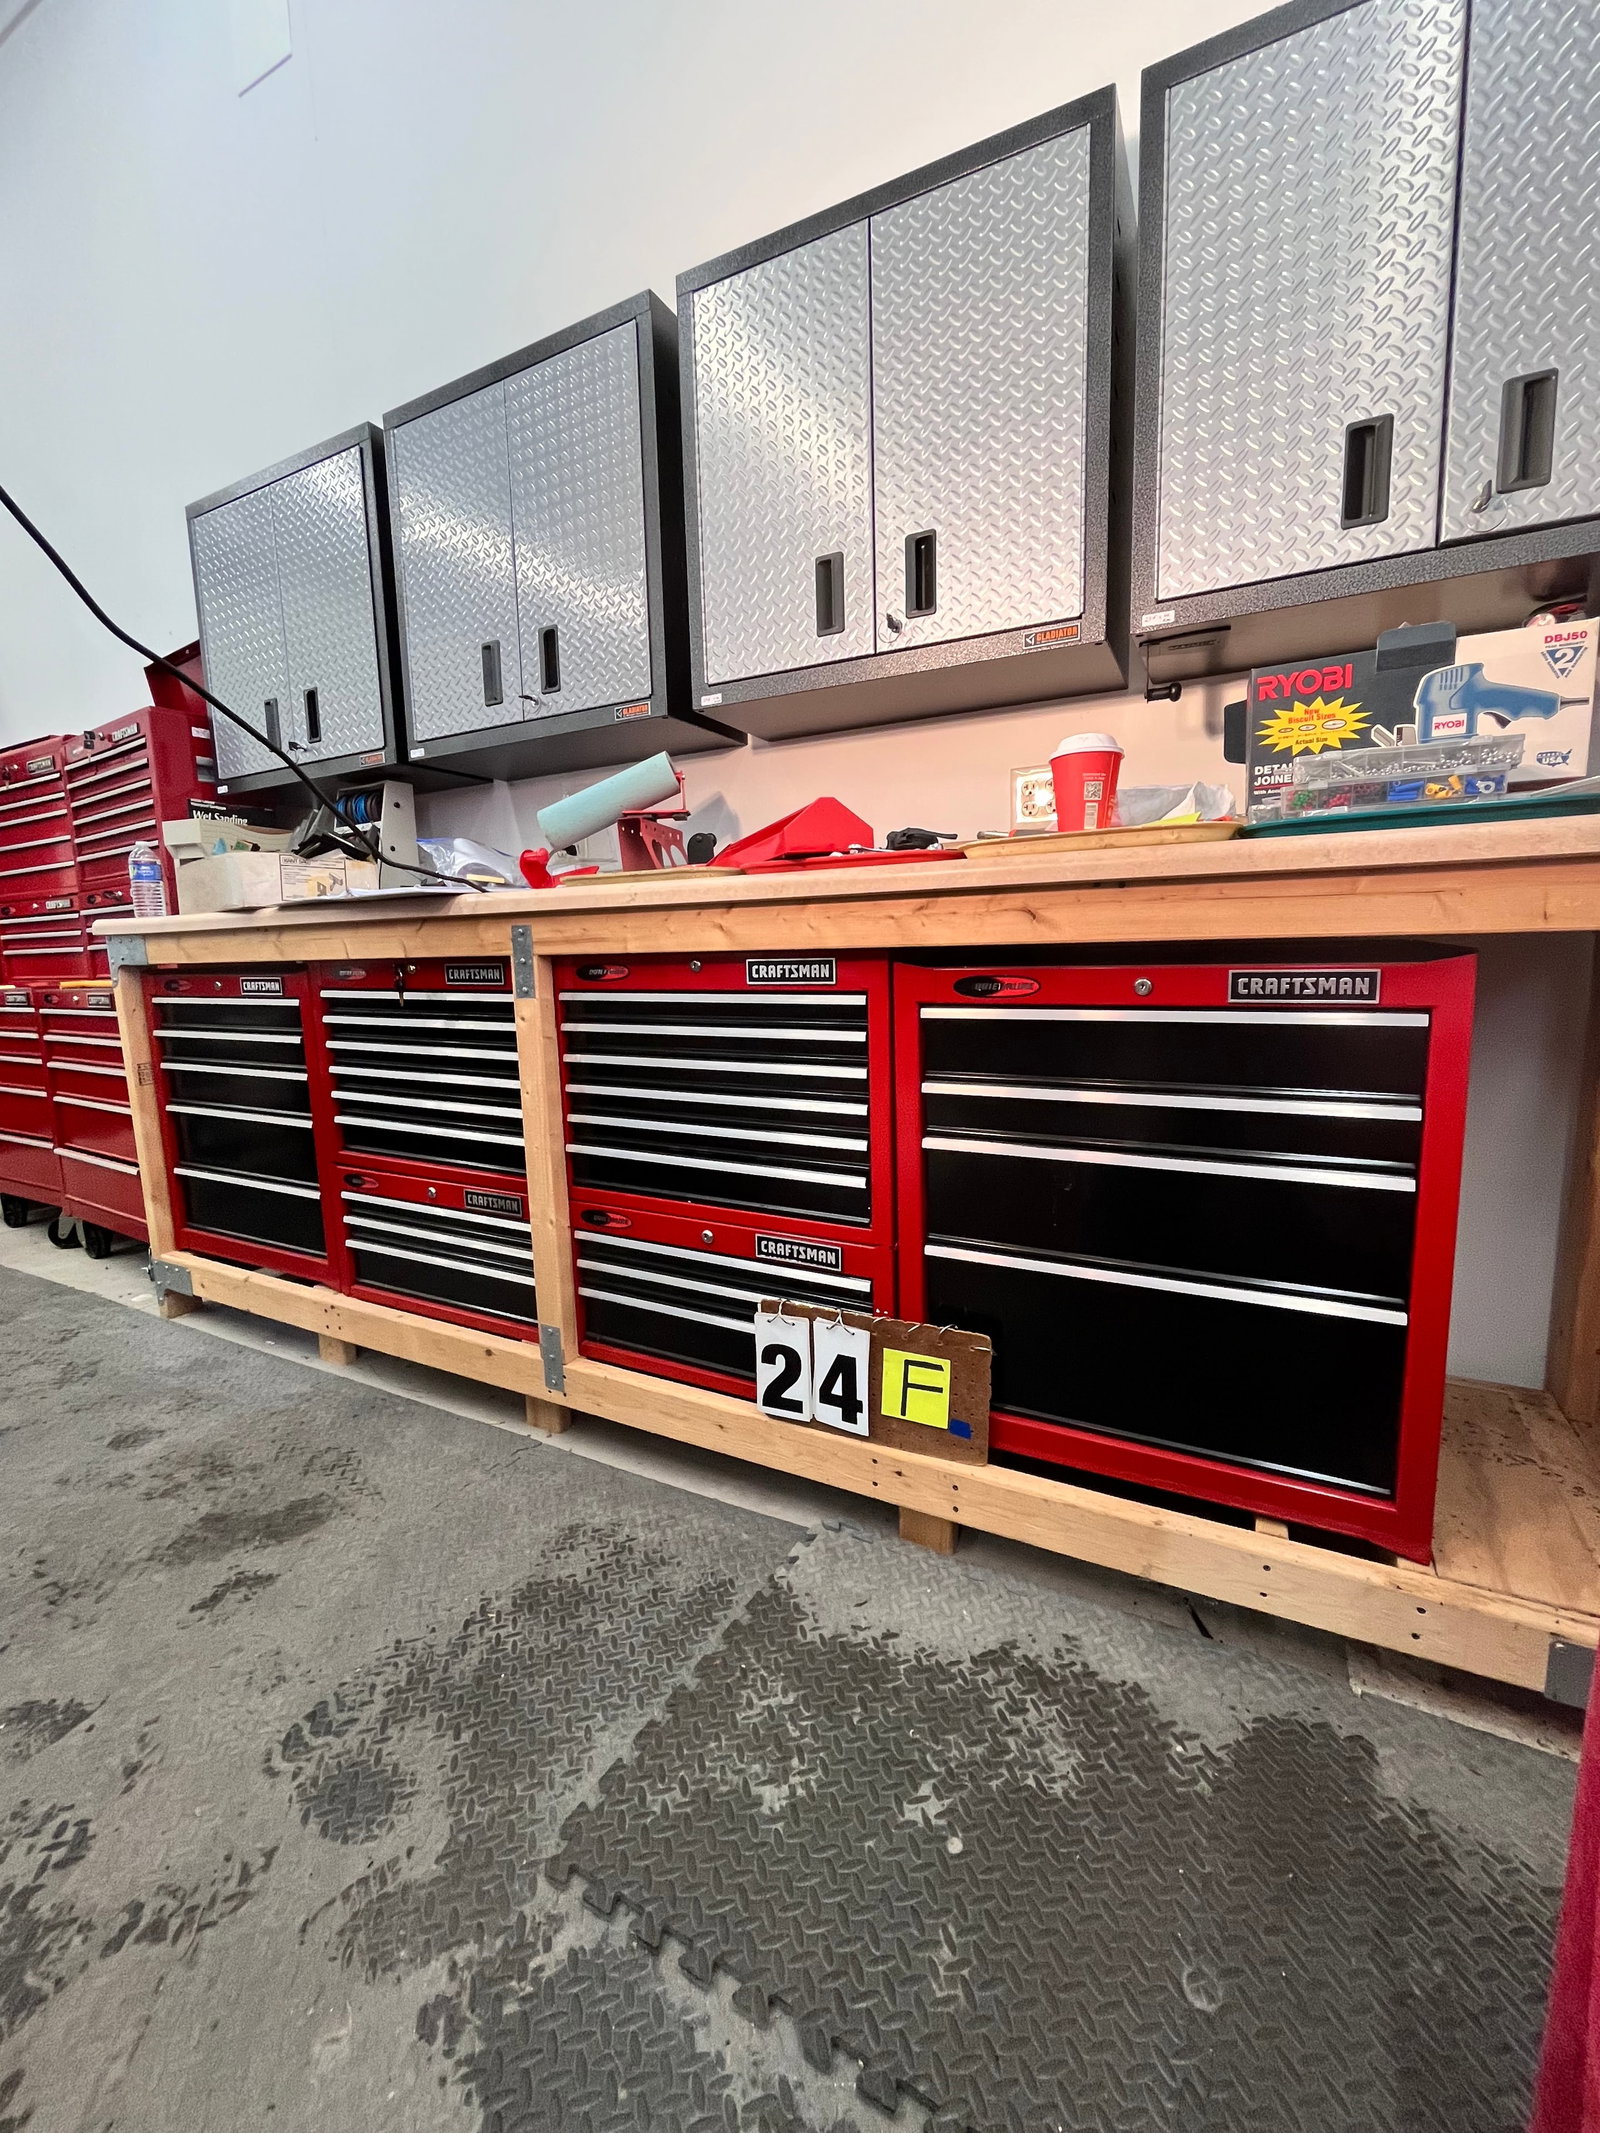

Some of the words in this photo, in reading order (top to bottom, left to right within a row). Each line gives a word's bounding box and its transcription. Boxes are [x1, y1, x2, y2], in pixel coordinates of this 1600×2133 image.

[1036, 625, 1078, 645] GLADIATOR
[1544, 630, 1588, 644] DBJ50
[1554, 648, 1575, 669] 2
[1256, 664, 1354, 701] RYOBI
[1288, 715, 1315, 725] Biscuit
[1315, 712, 1337, 721] Sizes
[1303, 708, 1321, 716] New
[1434, 719, 1465, 731] RYOBI
[1294, 737, 1314, 745] Actual
[1541, 755, 1564, 764] USA
[1254, 762, 1293, 776] DETAI
[1253, 774, 1293, 787] JOINE
[213, 812, 249, 825] Sanding
[449, 968, 501, 980] CRAFTSMAN
[751, 963, 830, 979] CRAFTSMAN
[242, 980, 281, 992] CRAFTSMAN
[1236, 976, 1371, 997] CRAFTSMAN
[466, 1193, 519, 1213] CRAFTSMAN
[760, 1239, 837, 1265] CRAFTSMAN
[900, 1358, 945, 1417] F
